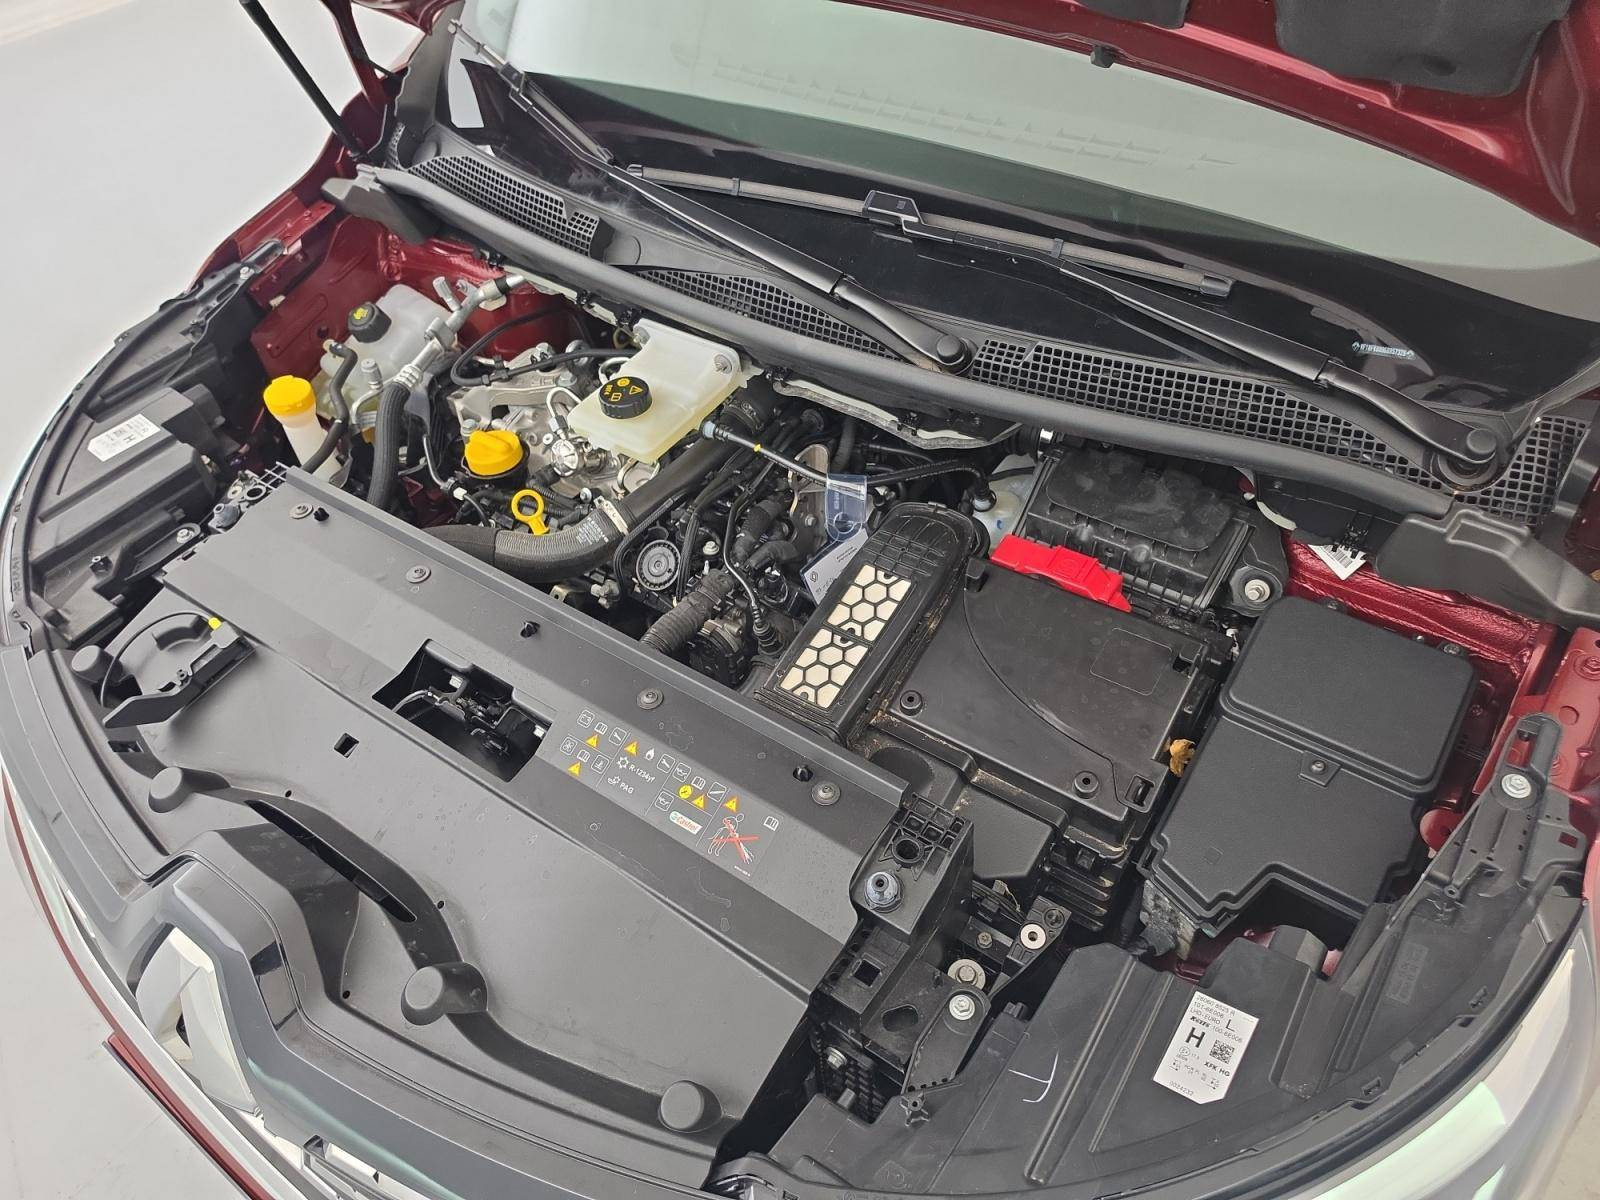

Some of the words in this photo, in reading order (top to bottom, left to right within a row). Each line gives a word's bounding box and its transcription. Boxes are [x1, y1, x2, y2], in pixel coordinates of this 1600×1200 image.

[628, 763, 656, 784] R-1234yf
[619, 781, 634, 794] PAG
[1225, 1018, 1236, 1032] L
[1185, 1026, 1206, 1048] H
[1203, 1061, 1218, 1071] XFK
